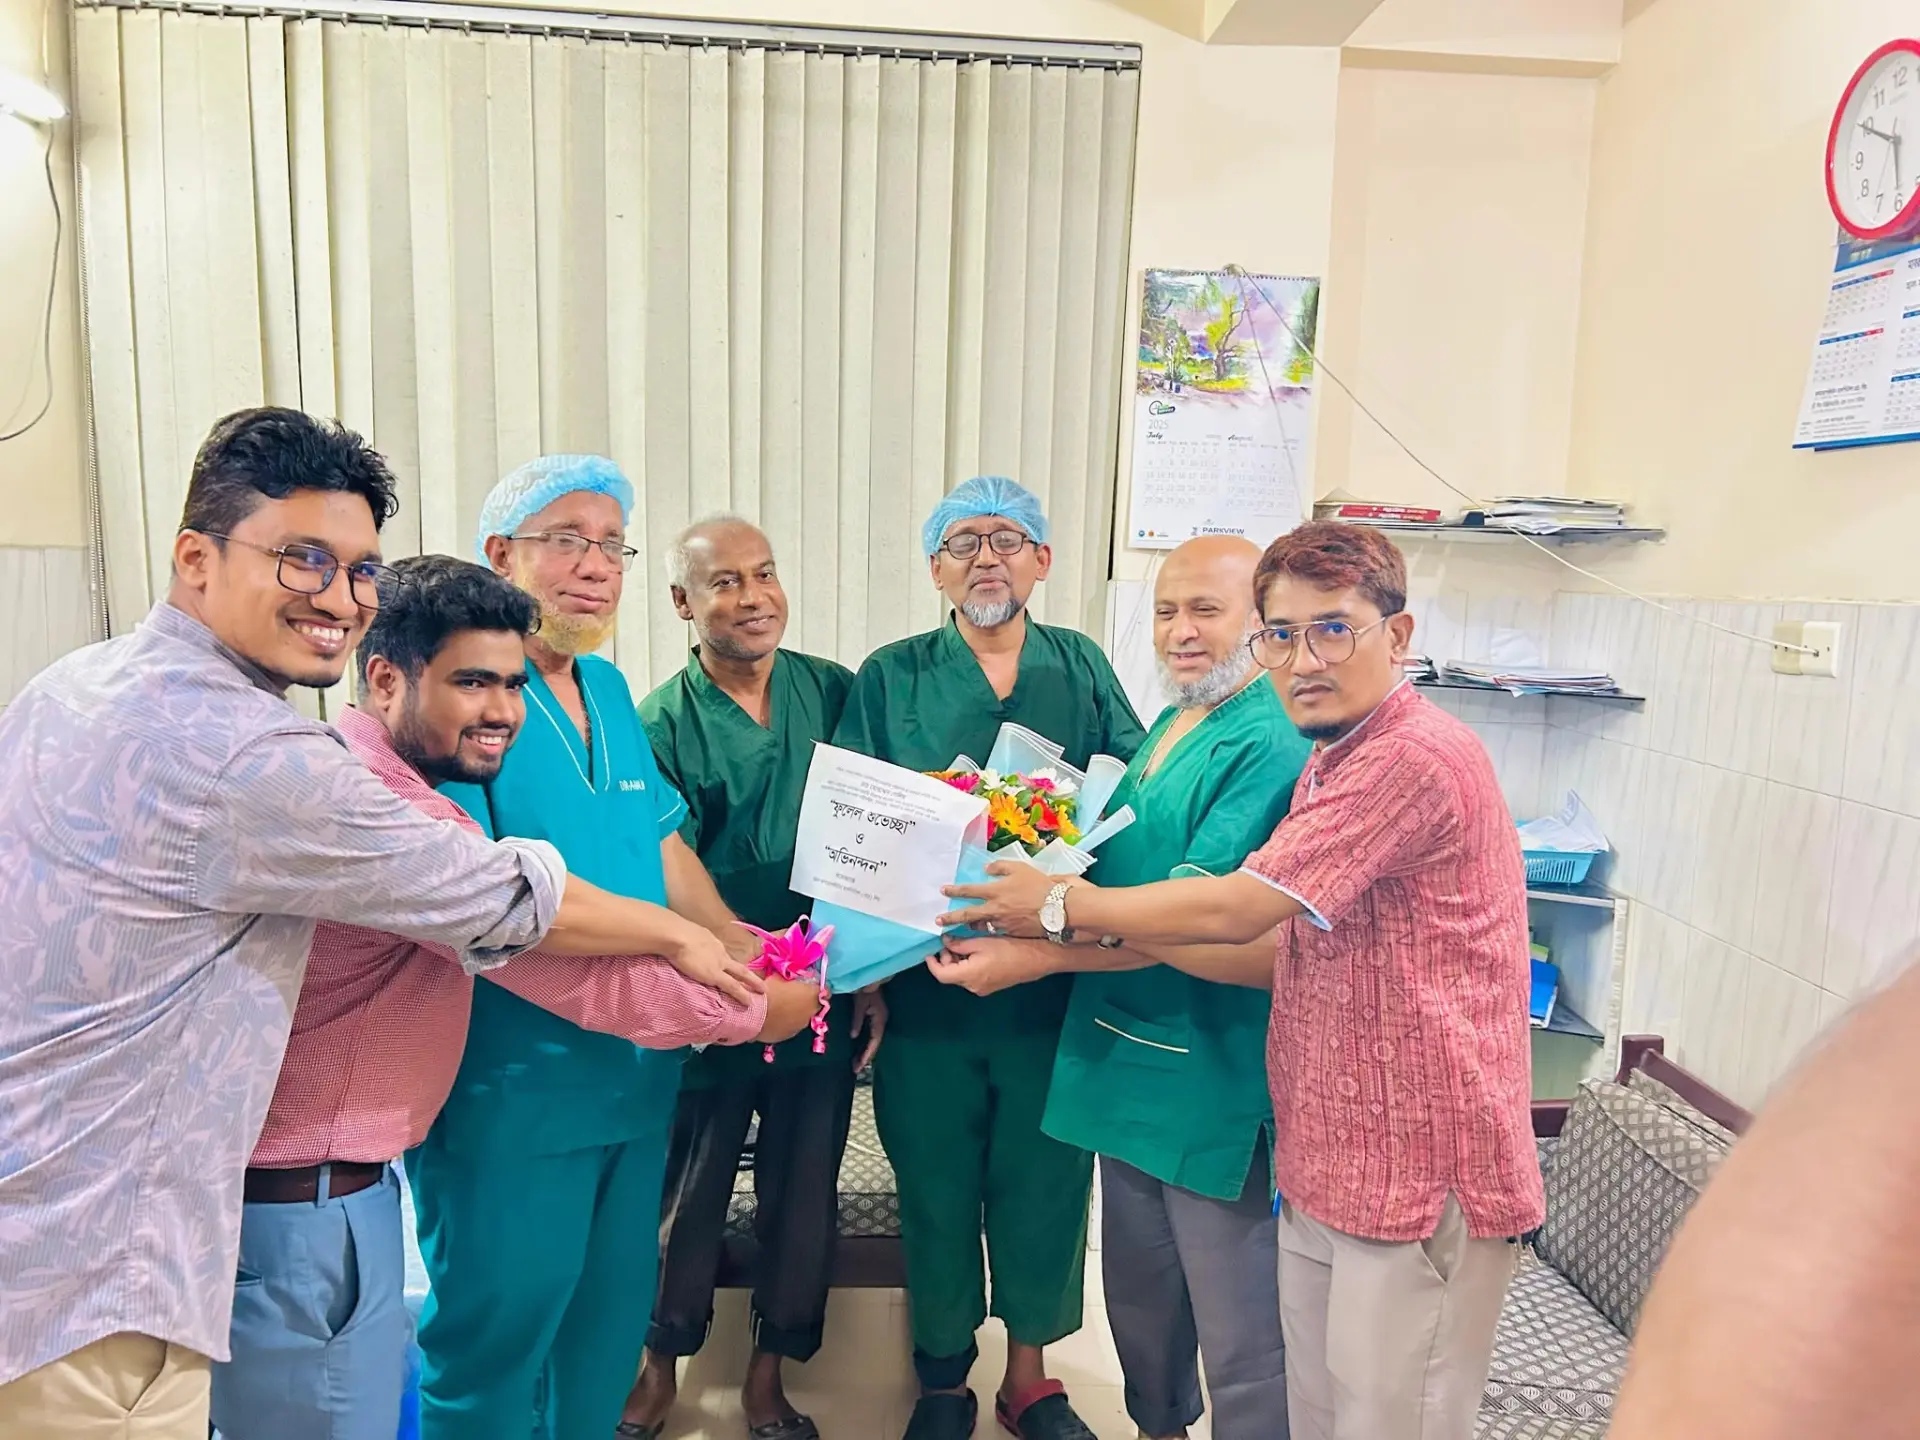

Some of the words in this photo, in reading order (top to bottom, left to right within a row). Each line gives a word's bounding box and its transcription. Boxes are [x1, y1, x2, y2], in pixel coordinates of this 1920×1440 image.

[1892, 66, 1908, 88] 12
[1873, 88, 1885, 109] 11
[1862, 116, 1874, 137] 10
[1855, 151, 1864, 170] 9
[1861, 178, 1869, 197] 8
[1875, 193, 1884, 213] 7
[1894, 193, 1903, 212] 6
[1148, 419, 1169, 430] 2025
[1146, 431, 1163, 439] July
[1202, 526, 1245, 535] PARKVIEW
[856, 832, 864, 844] ও
